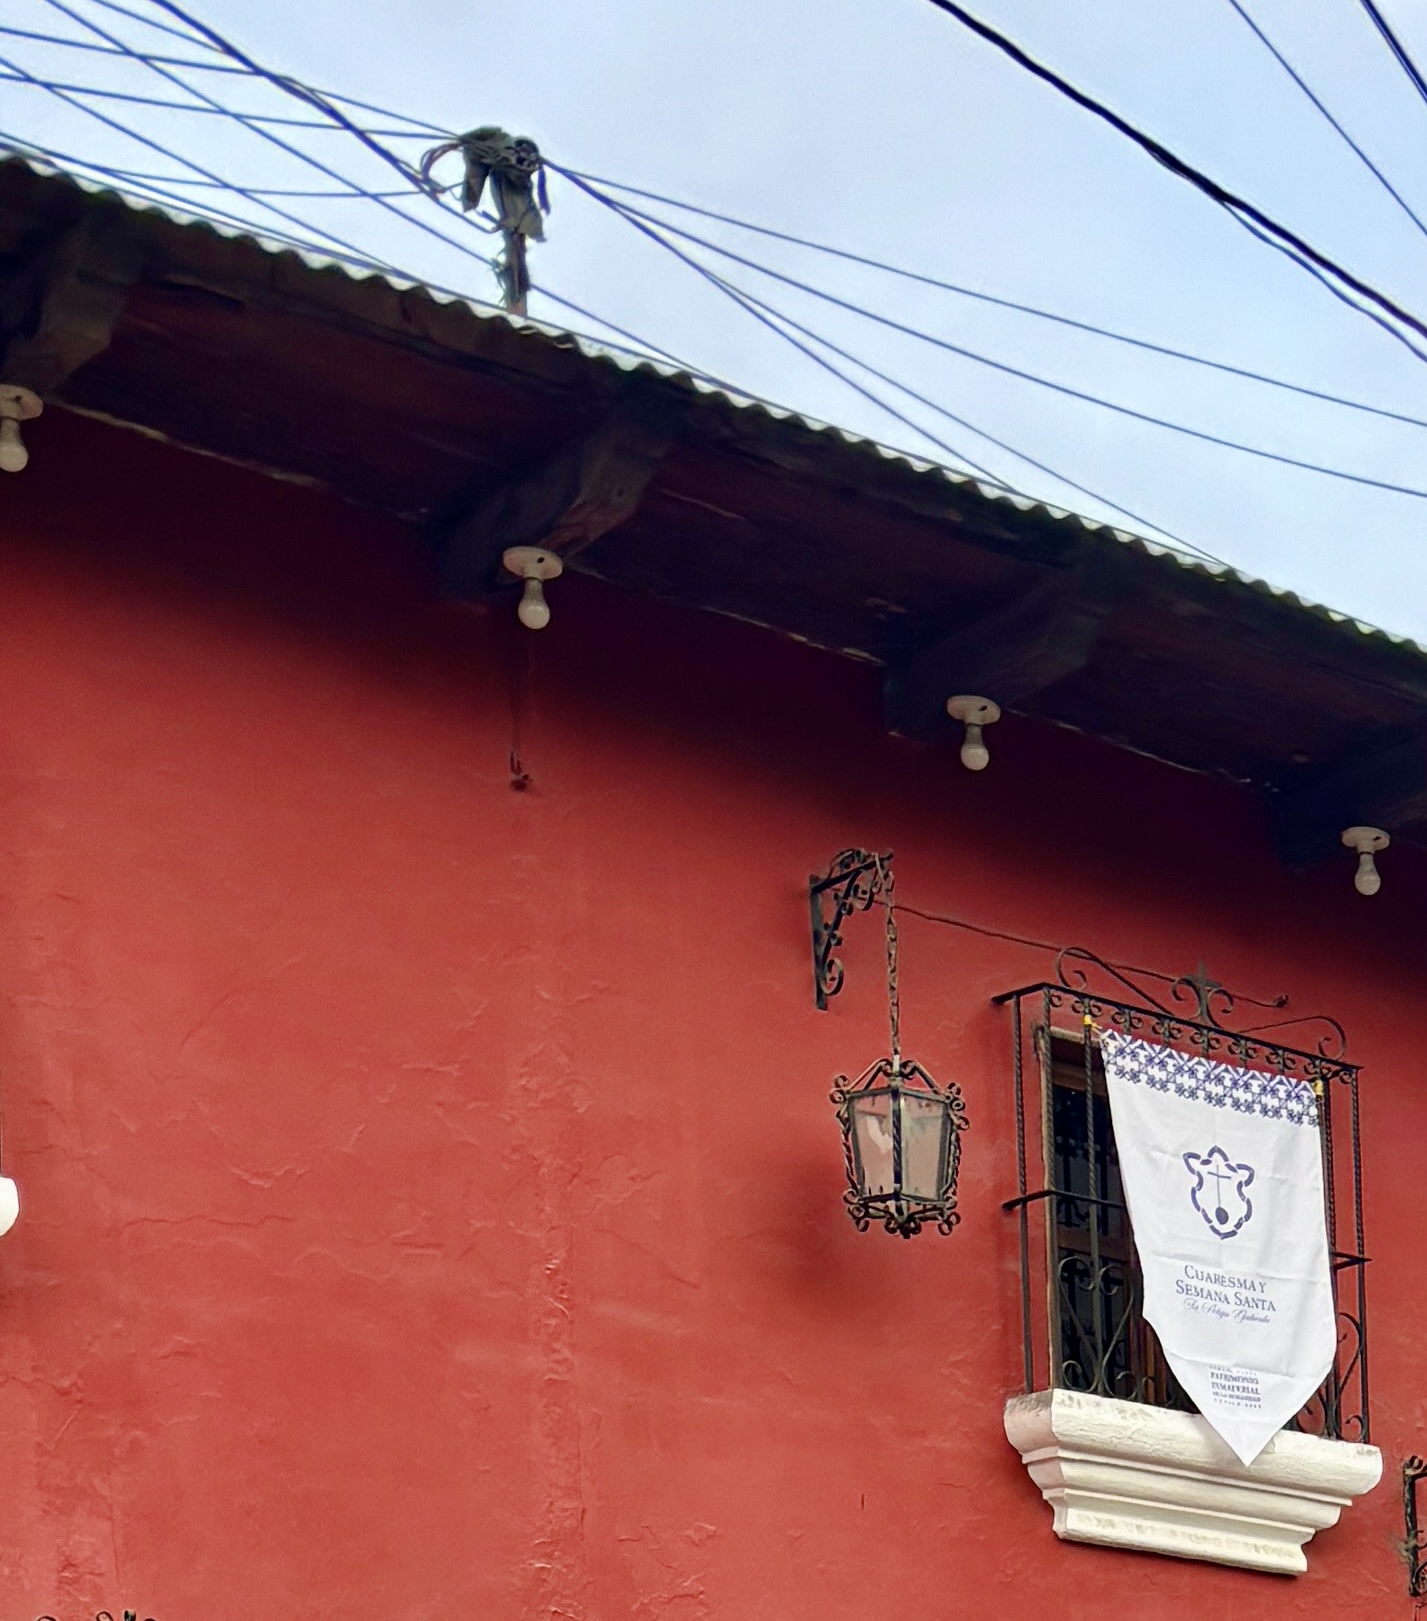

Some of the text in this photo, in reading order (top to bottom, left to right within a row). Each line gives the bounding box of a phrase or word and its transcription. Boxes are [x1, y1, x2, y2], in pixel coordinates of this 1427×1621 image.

[1184, 1264, 1256, 1292] CUARESMA
[1175, 1278, 1277, 1312] SEMANA SANTA
